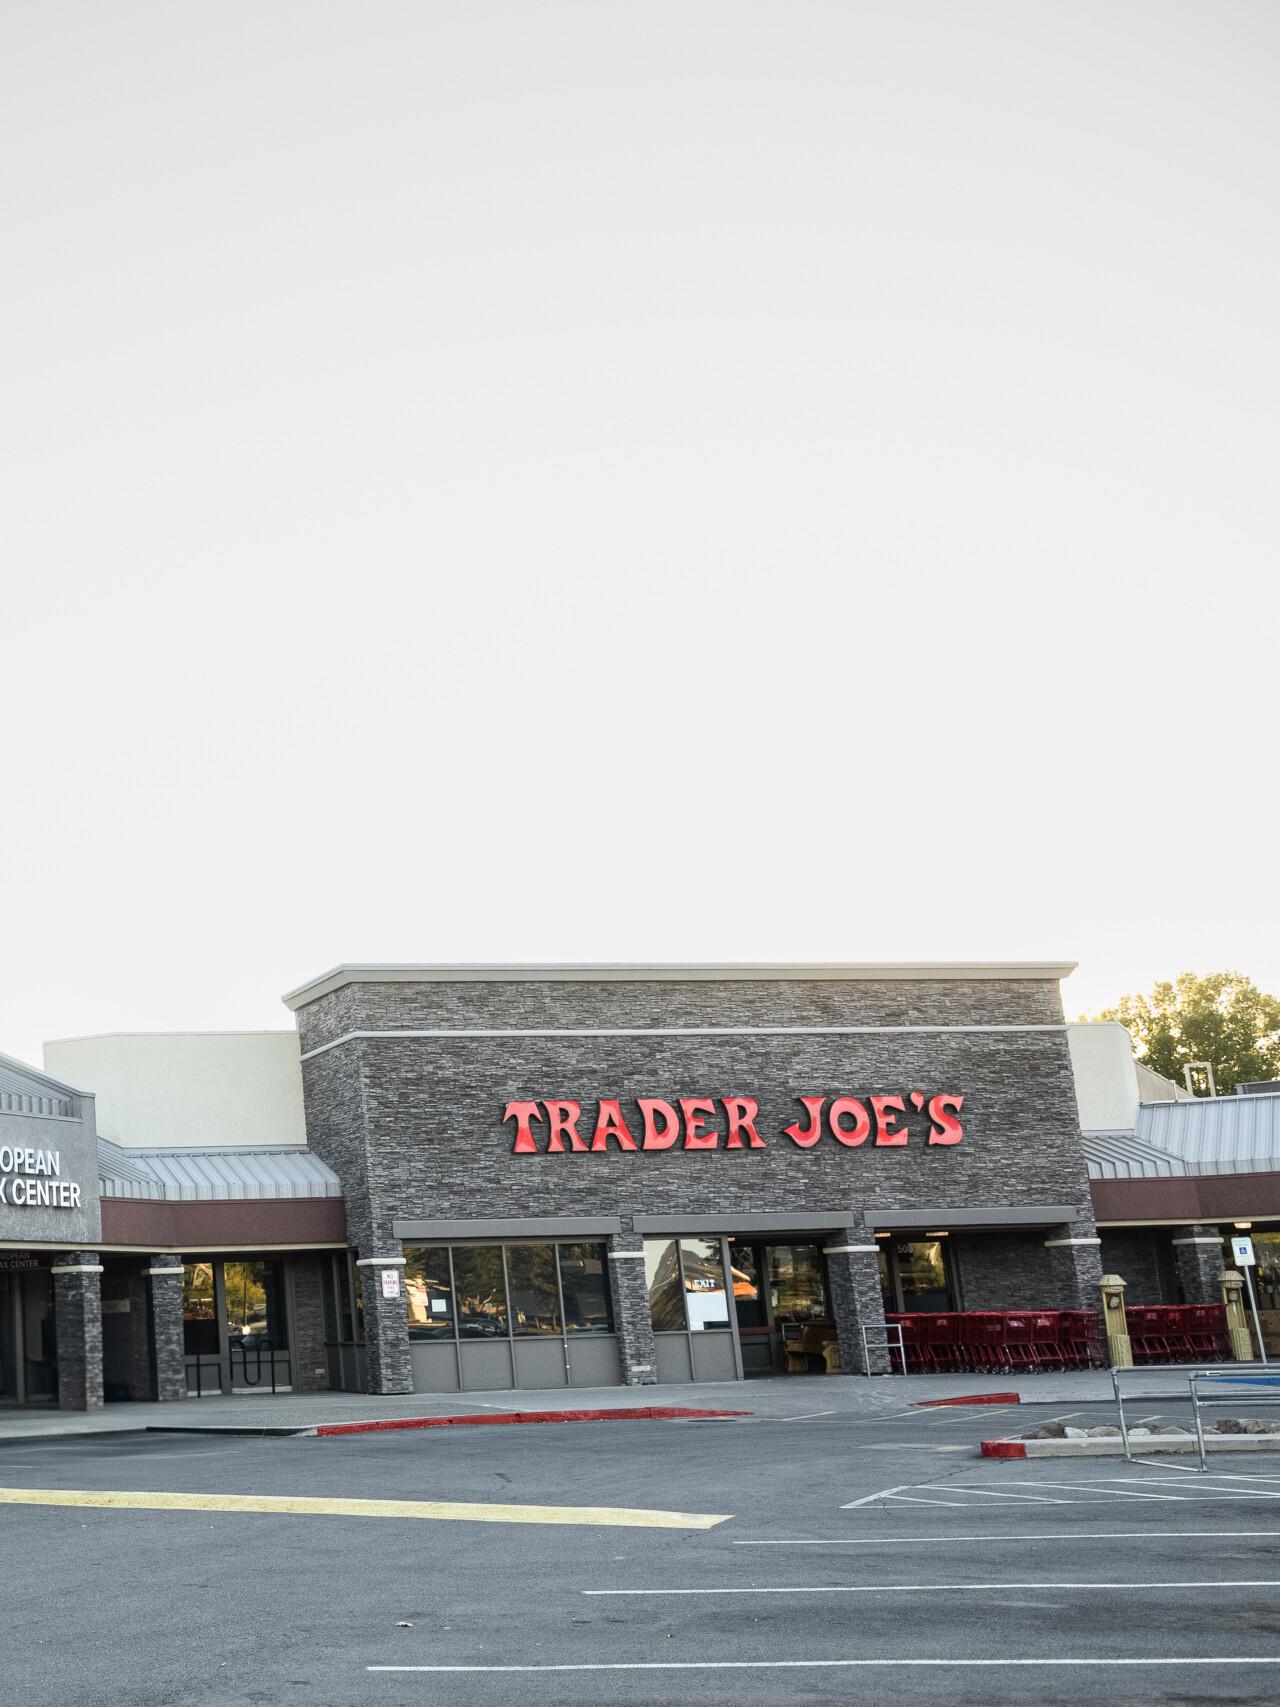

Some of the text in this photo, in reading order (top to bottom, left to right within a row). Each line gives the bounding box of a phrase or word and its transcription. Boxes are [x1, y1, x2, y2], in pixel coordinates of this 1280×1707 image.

[502, 1091, 965, 1153] TRADER JOE'S
[10, 1178, 81, 1208] CENTER
[10, 1259, 39, 1269] CENTER
[694, 1279, 716, 1288] EXIT
